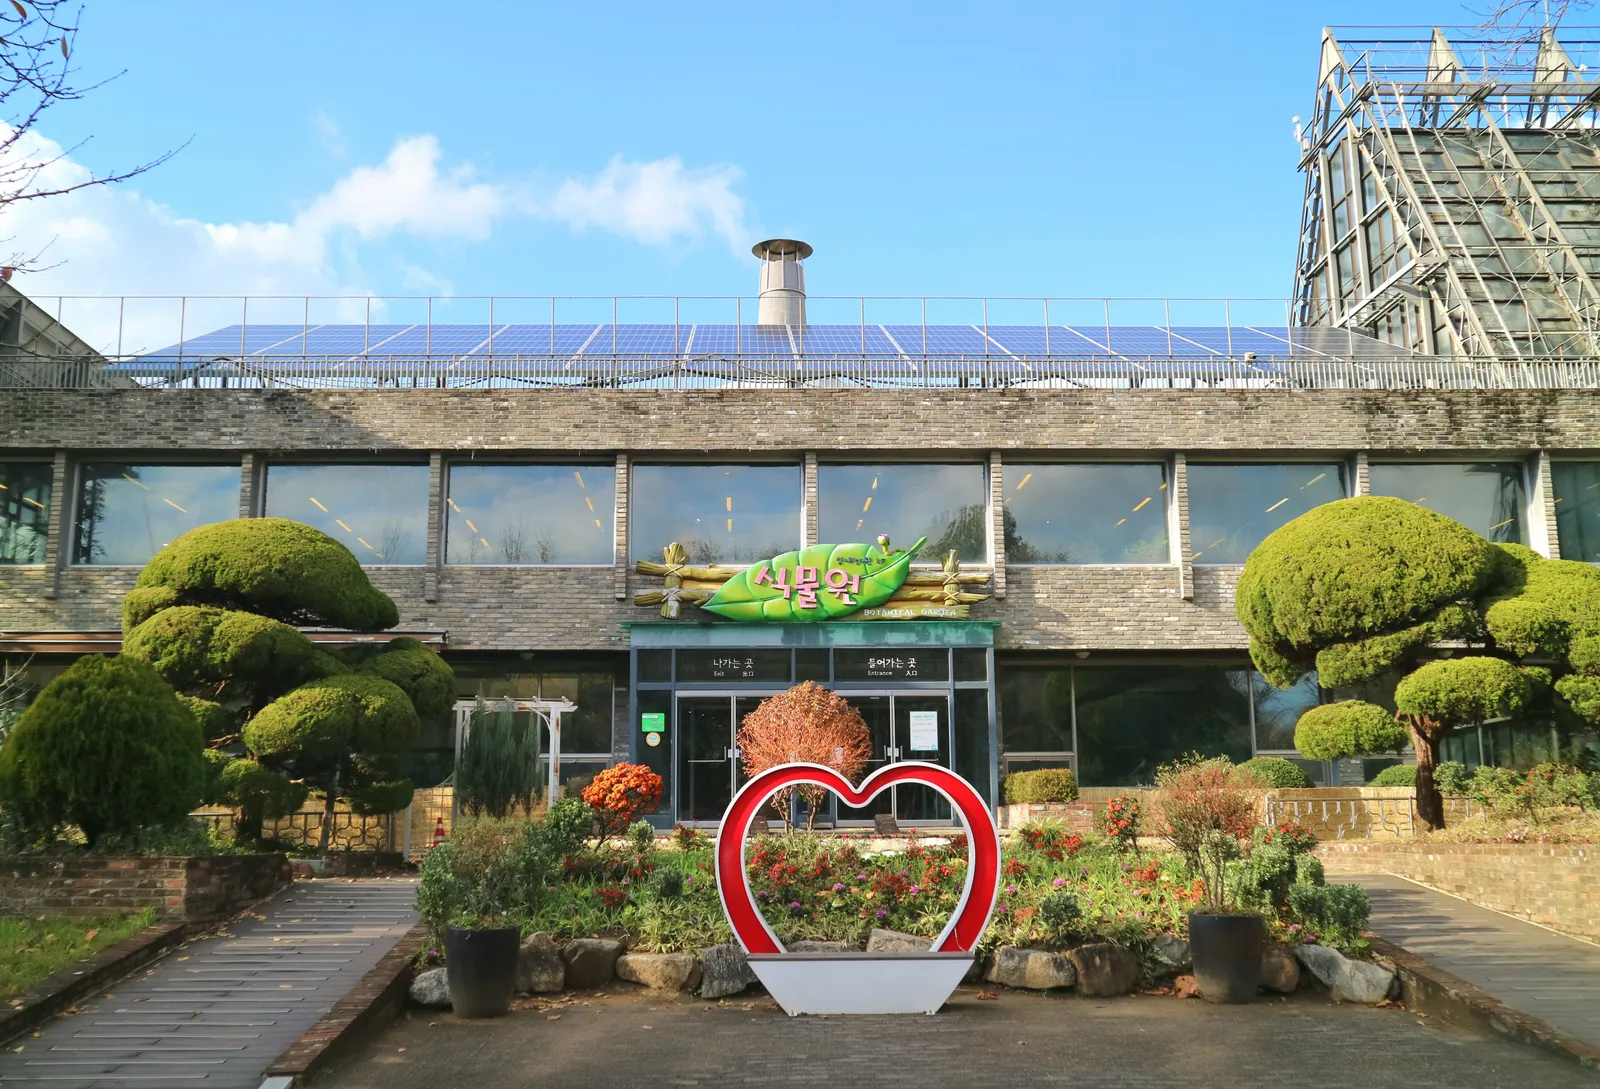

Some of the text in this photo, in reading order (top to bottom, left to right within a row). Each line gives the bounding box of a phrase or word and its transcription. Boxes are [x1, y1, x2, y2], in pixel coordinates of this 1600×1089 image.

[754, 565, 860, 609] 식물원
[864, 608, 956, 617] BOTANICAL GARDEN
[713, 658, 754, 669] 나가는 곳
[867, 657, 917, 669] 들어가는 곳
